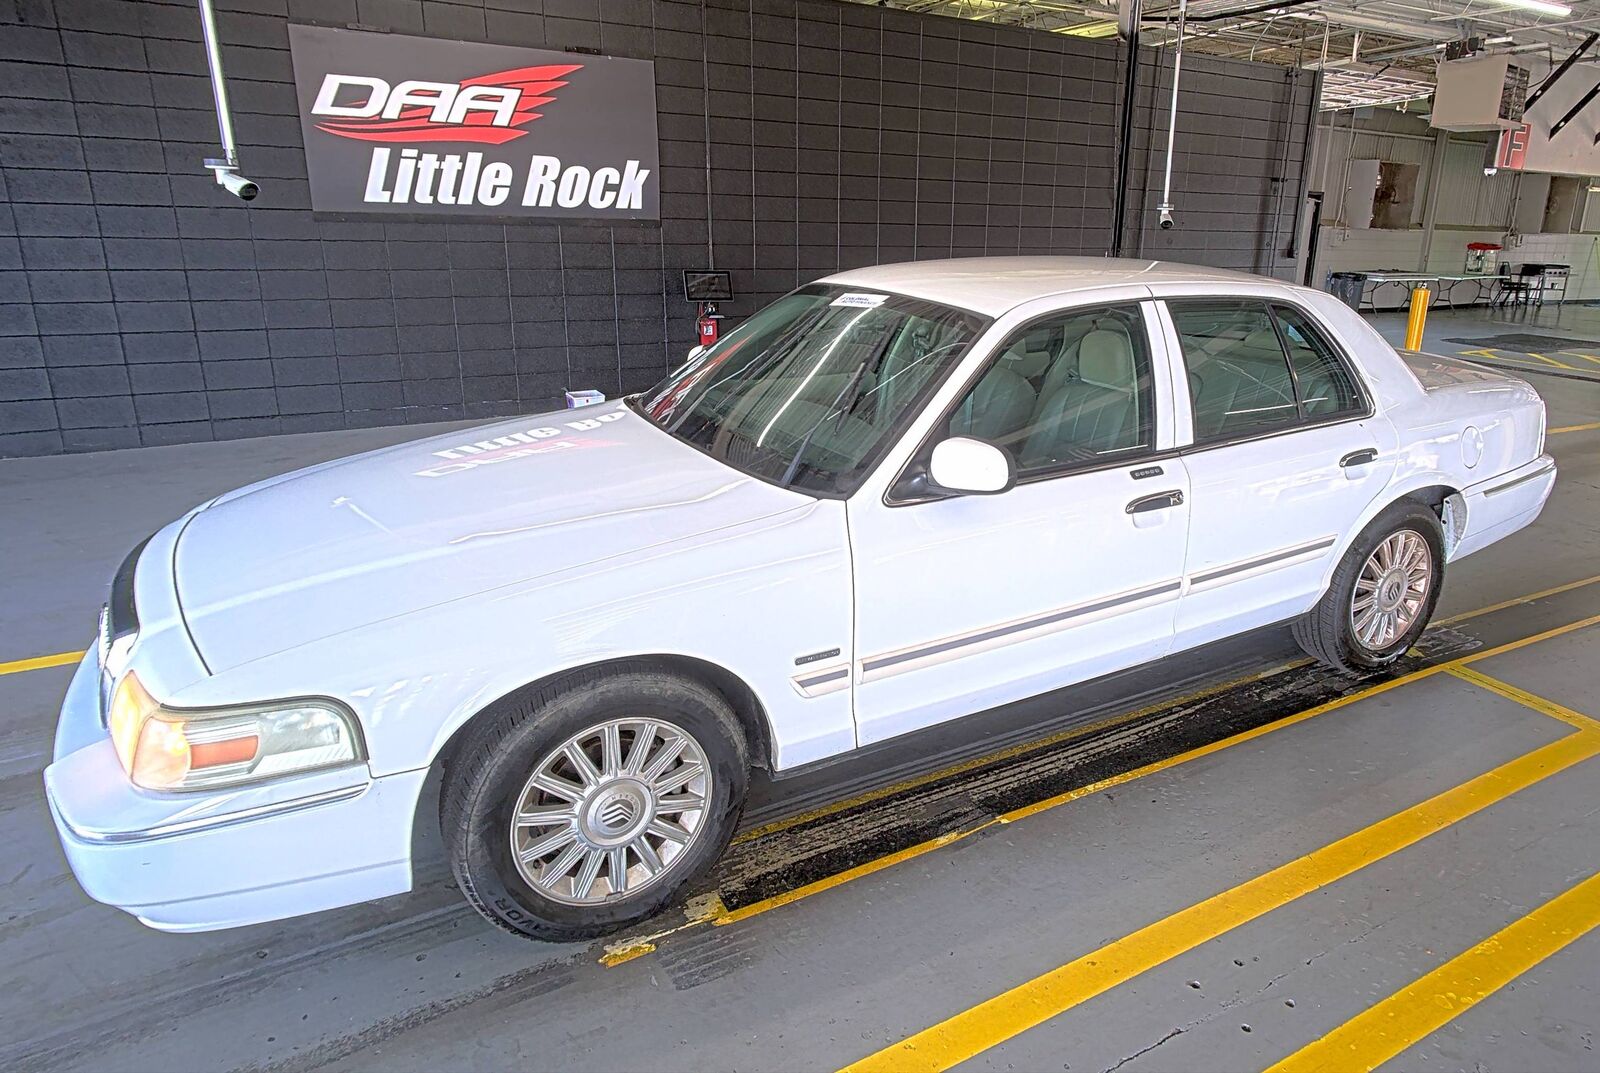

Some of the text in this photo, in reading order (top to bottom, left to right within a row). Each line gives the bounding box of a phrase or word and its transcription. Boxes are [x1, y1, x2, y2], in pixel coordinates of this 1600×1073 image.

[310, 73, 522, 127] DAA
[363, 147, 651, 210] Little Rock
